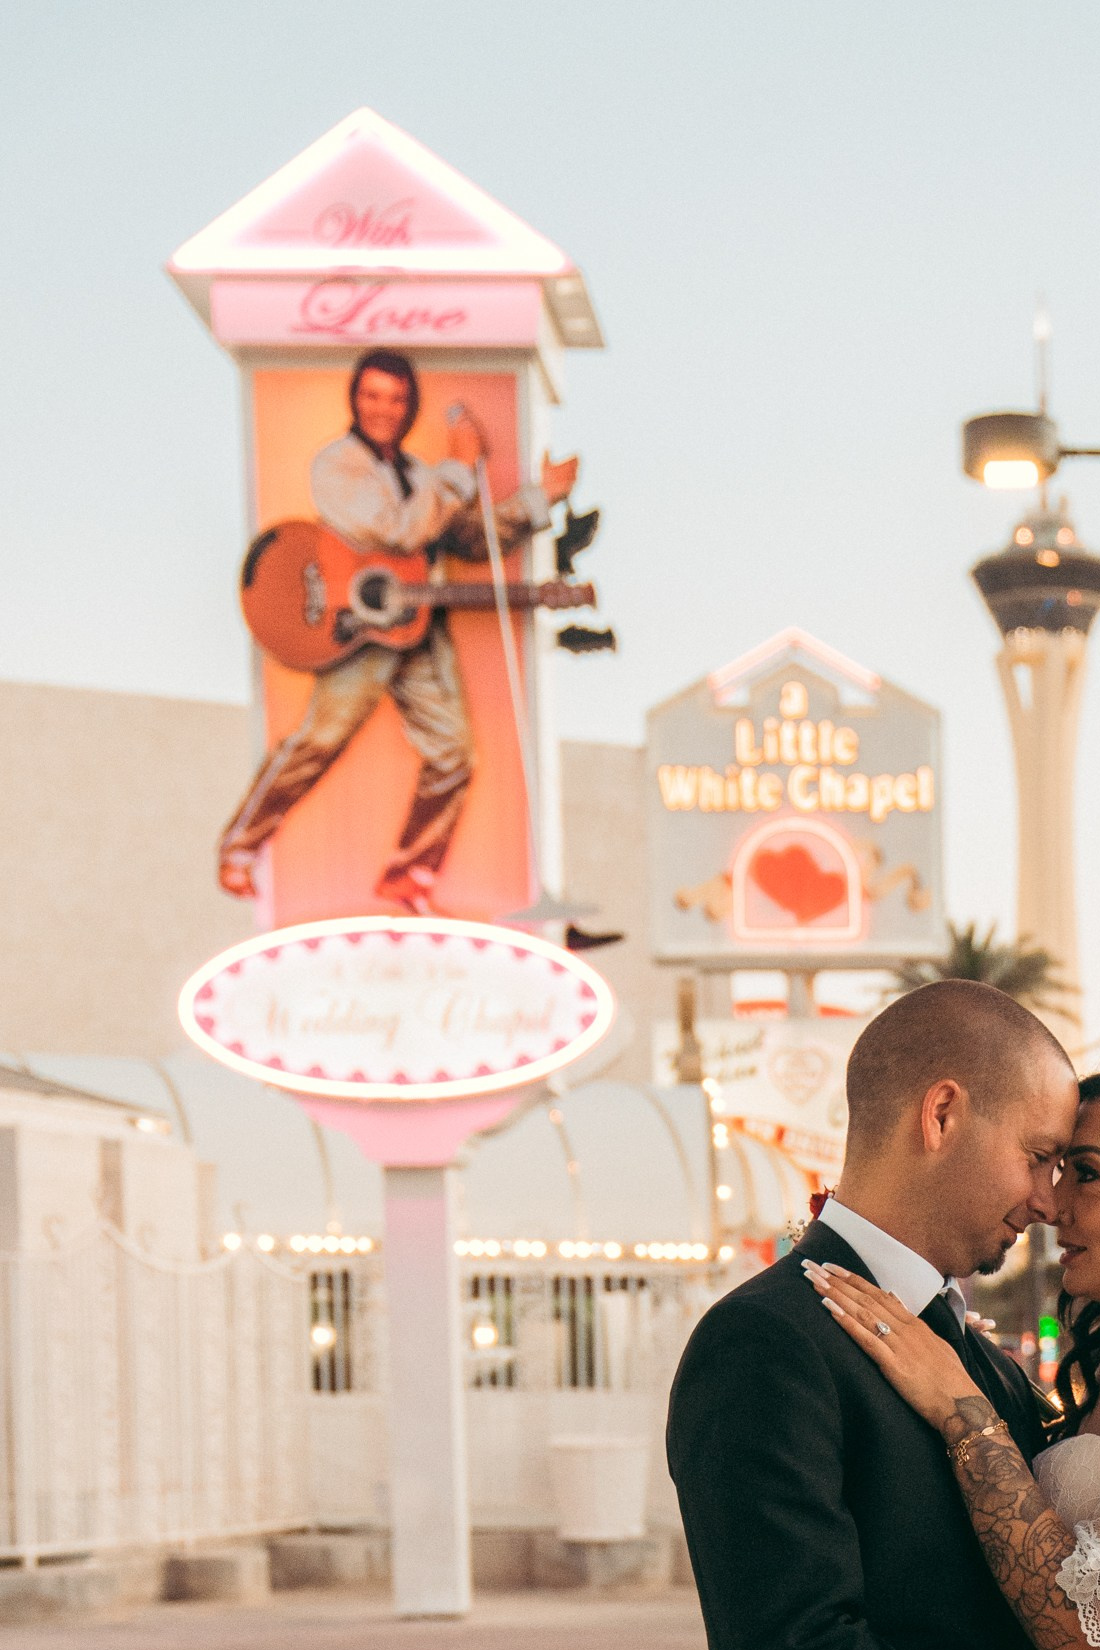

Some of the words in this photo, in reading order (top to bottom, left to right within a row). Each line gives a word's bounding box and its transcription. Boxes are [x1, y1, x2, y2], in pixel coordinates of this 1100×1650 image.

[291, 266, 468, 341] Love
[735, 717, 859, 766] Little
[658, 764, 783, 812] White
[788, 764, 934, 824] Chapel
